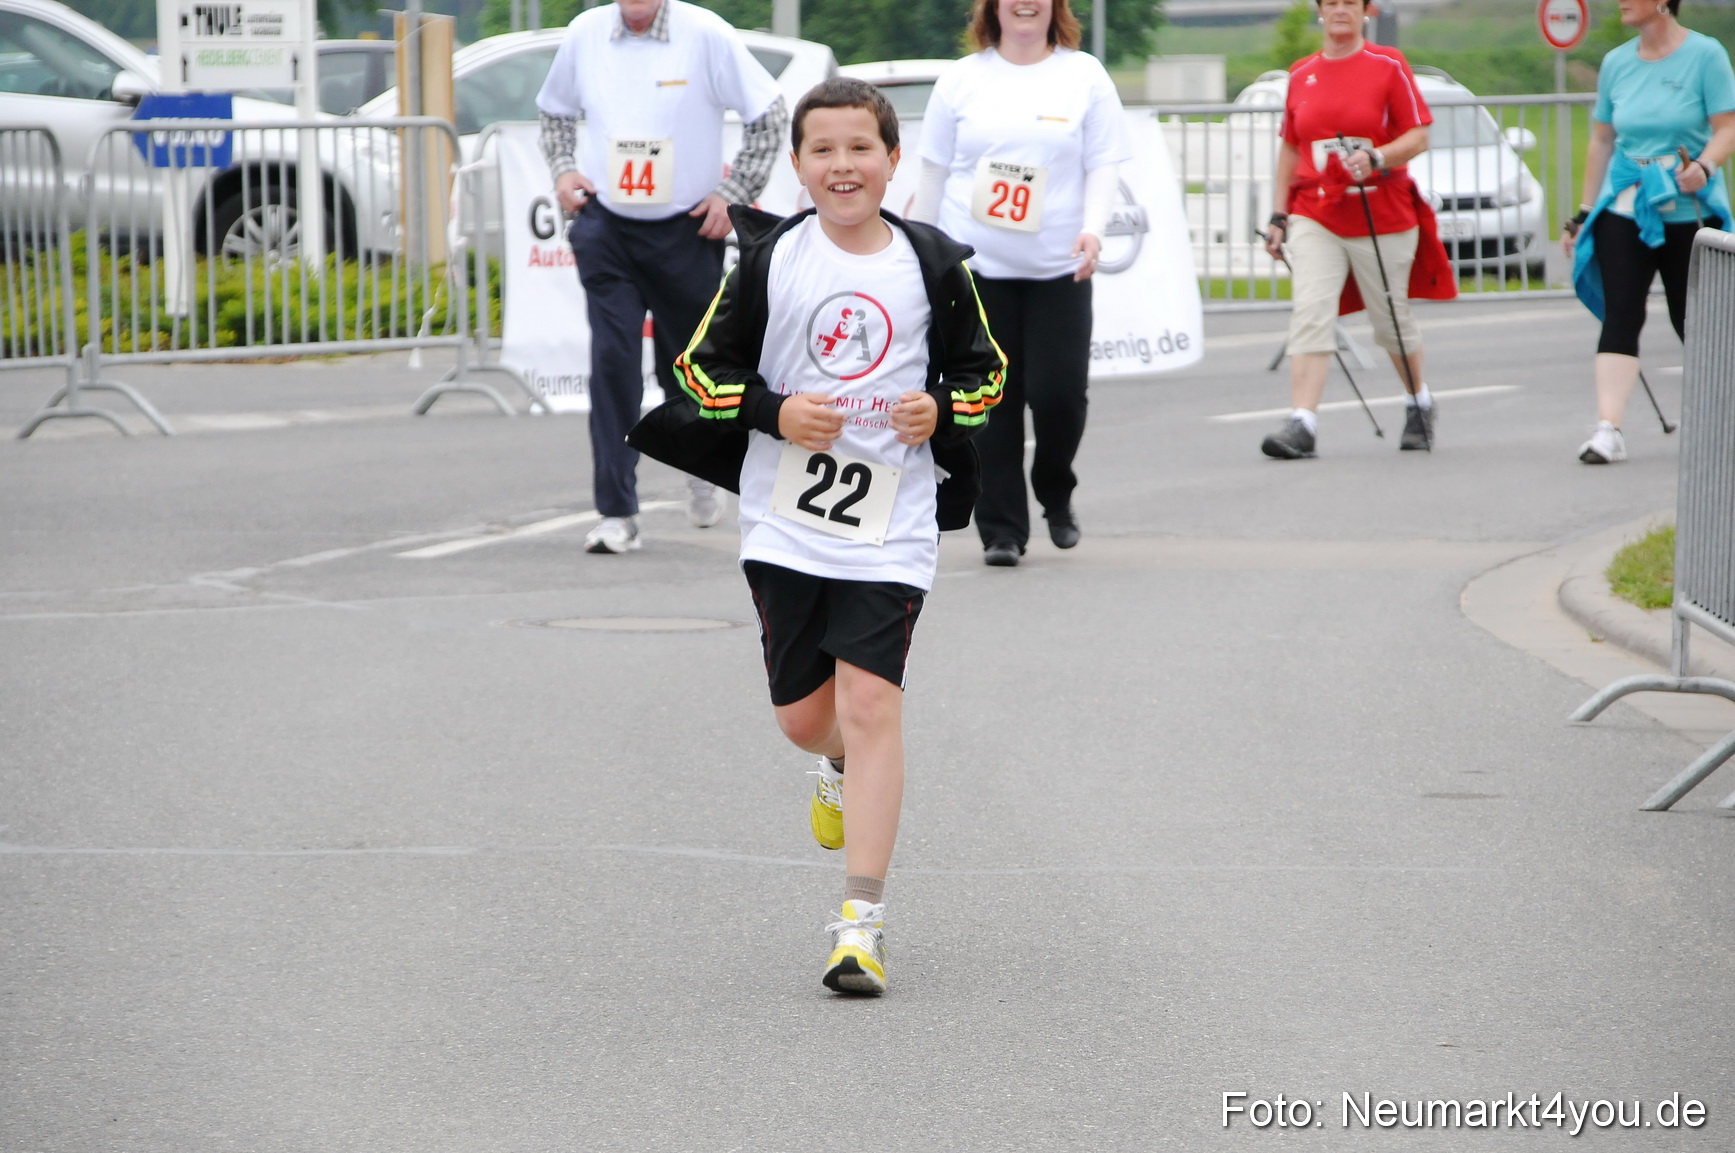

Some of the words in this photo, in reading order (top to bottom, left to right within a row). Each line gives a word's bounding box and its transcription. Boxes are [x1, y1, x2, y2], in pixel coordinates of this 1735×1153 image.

[618, 159, 655, 196] 44
[987, 180, 1031, 222] 29
[835, 396, 864, 410] MIT
[796, 452, 872, 528] 22
